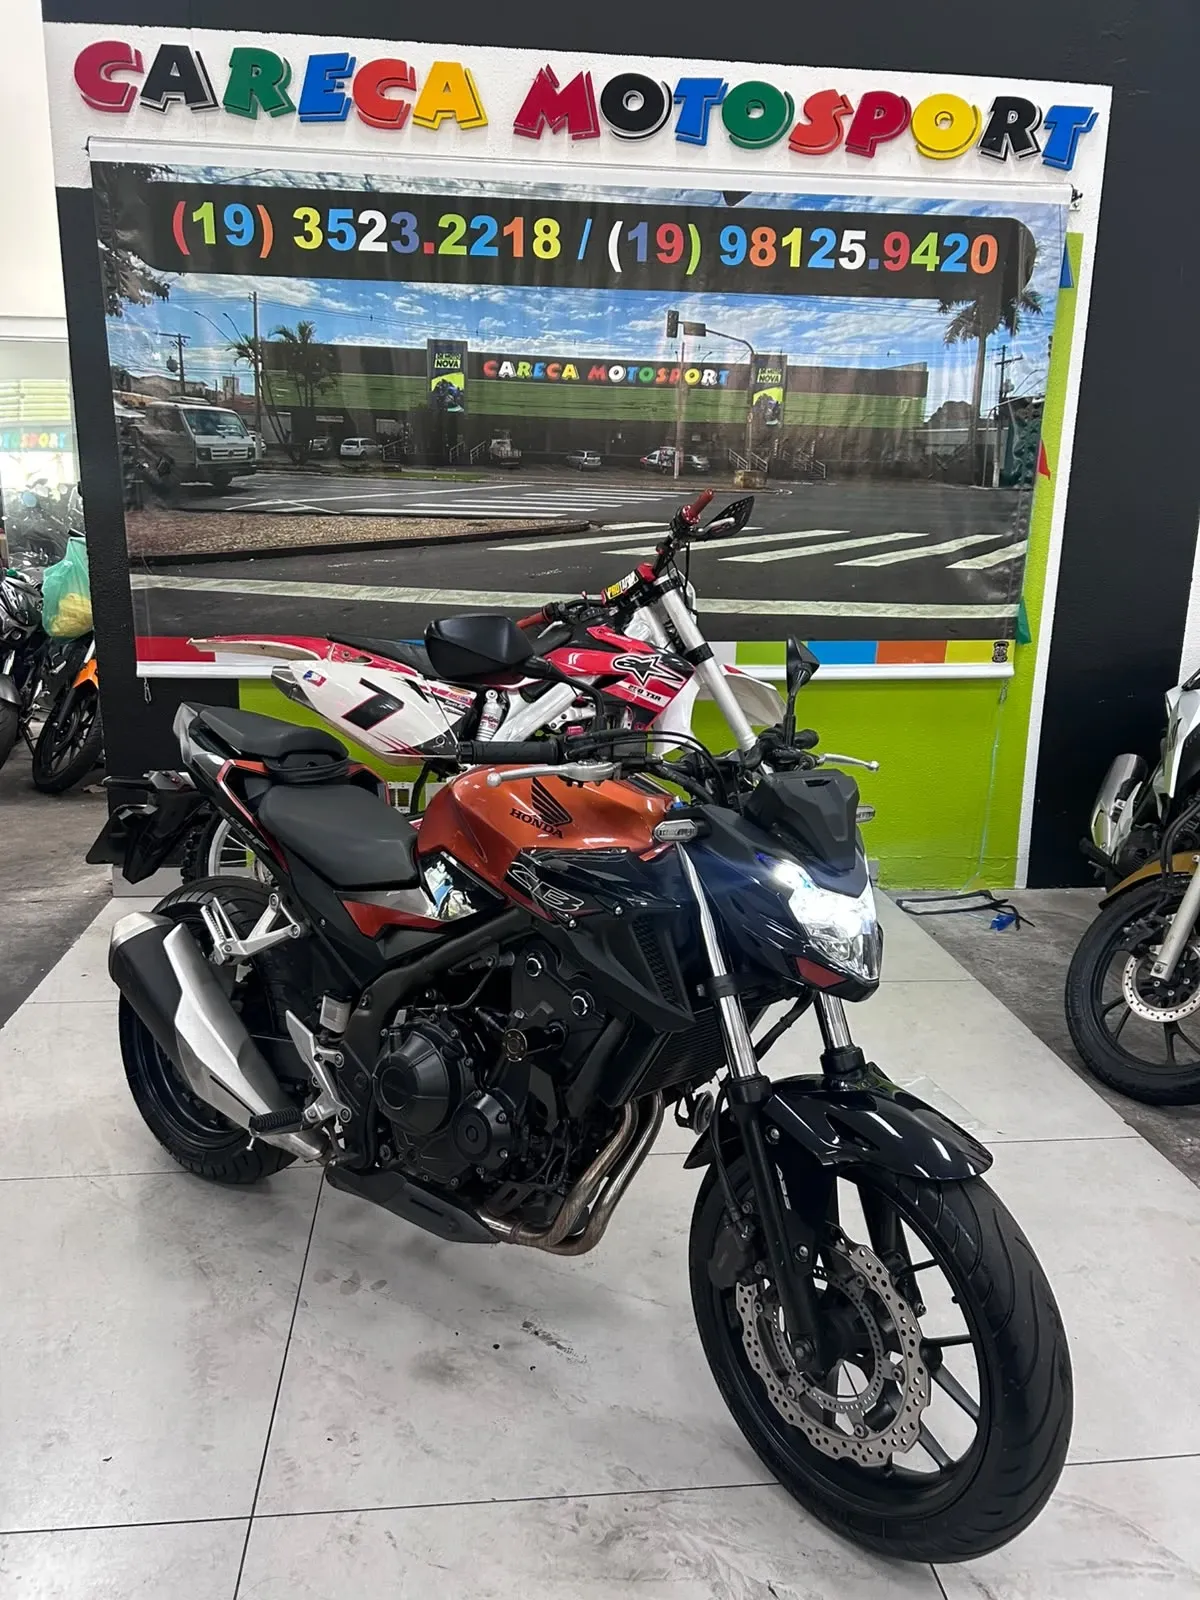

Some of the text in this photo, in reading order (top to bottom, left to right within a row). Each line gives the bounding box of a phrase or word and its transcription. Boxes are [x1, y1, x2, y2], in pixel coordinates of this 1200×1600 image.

[73, 40, 1098, 171] CARECA MOTOSPORT
[171, 200, 274, 259] (19)
[292, 206, 562, 261] 3523.2218
[607, 220, 701, 276] (19)
[720, 225, 999, 275] 98125.9420
[436, 360, 459, 368] NOVA
[482, 359, 730, 386] CARECA MOTOSPORT
[509, 808, 564, 839] HONDA
[506, 861, 585, 912] CB
